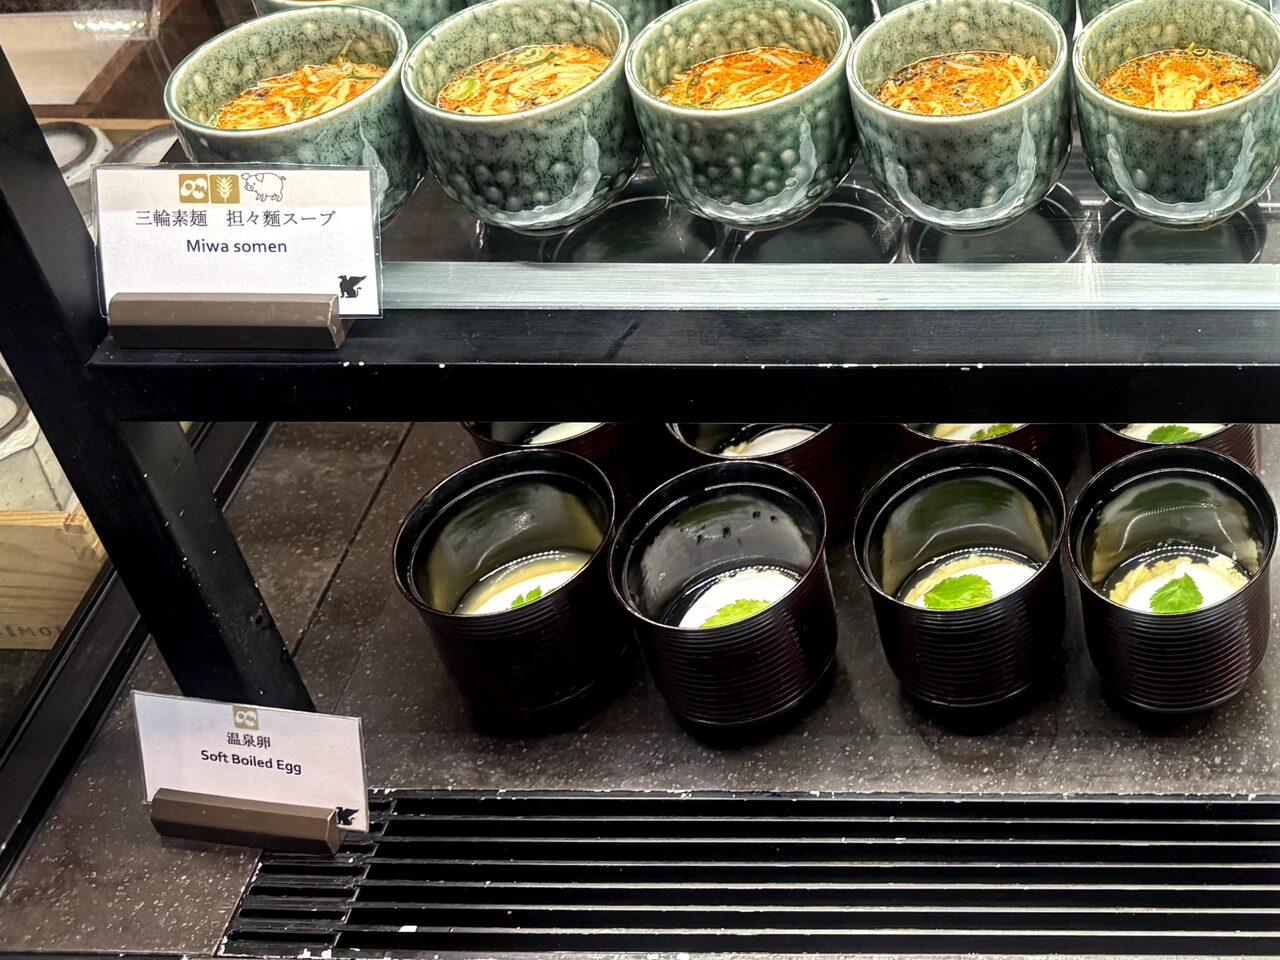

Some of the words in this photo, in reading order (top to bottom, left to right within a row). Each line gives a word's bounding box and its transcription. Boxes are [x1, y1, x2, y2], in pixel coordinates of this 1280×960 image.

[135, 210, 208, 227] 三輪素麺
[186, 238, 229, 253] Miwa
[233, 241, 287, 253] somen
[226, 732, 271, 749] 温泉卵
[201, 749, 229, 763] Soft
[232, 754, 273, 769] Boiled
[277, 759, 301, 775] Egg
